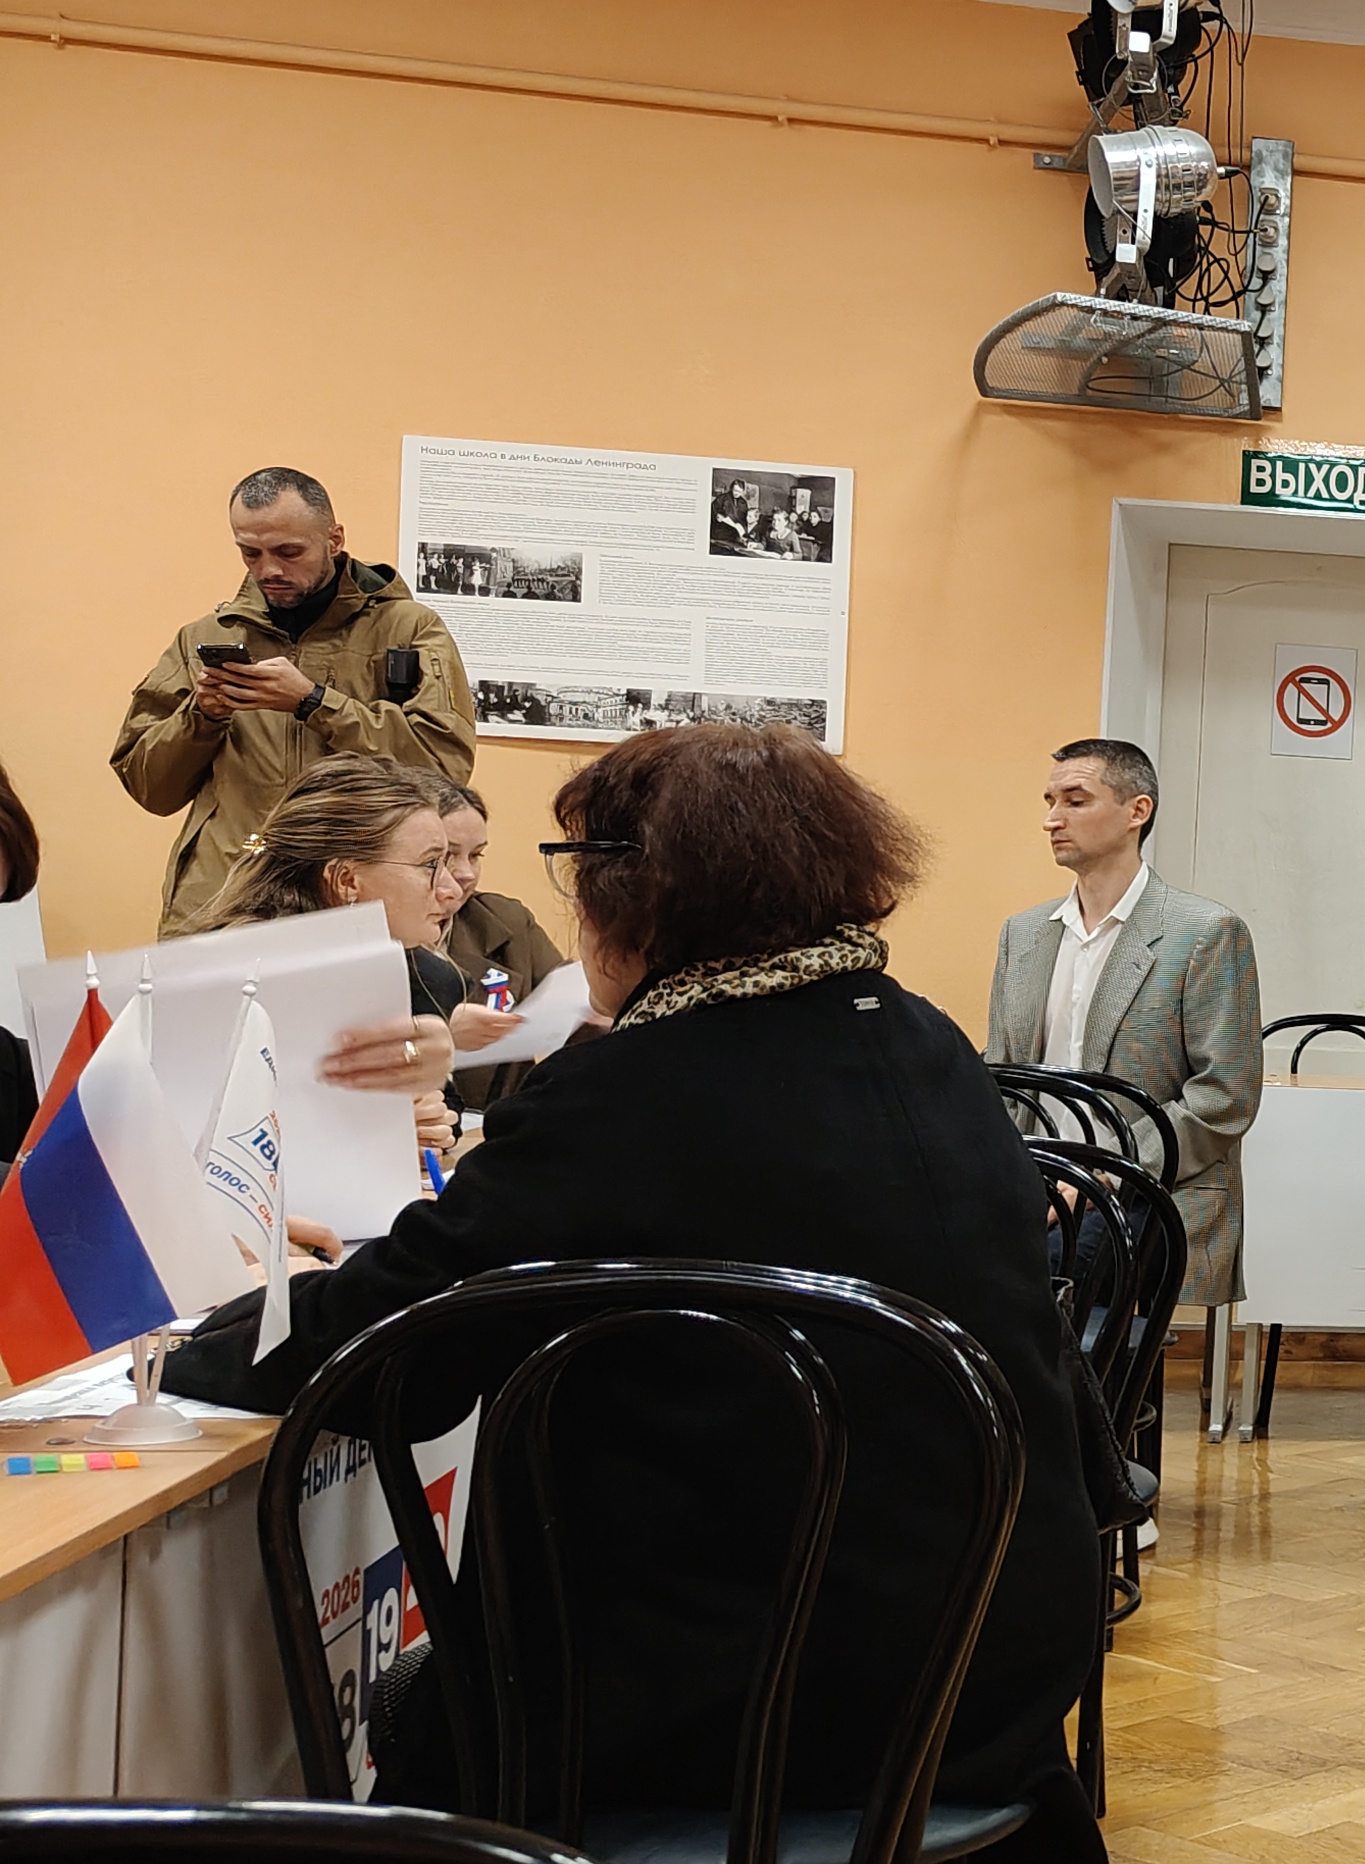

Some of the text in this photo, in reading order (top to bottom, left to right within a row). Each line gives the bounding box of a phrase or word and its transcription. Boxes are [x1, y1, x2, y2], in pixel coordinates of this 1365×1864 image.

[420, 446, 455, 457] Наша
[458, 449, 497, 460] школа
[533, 454, 583, 466] Блокады
[585, 458, 657, 472] Ленинграда
[251, 1128, 277, 1161] 18
[318, 1567, 362, 1629] 2026
[366, 1586, 400, 1684] 19
